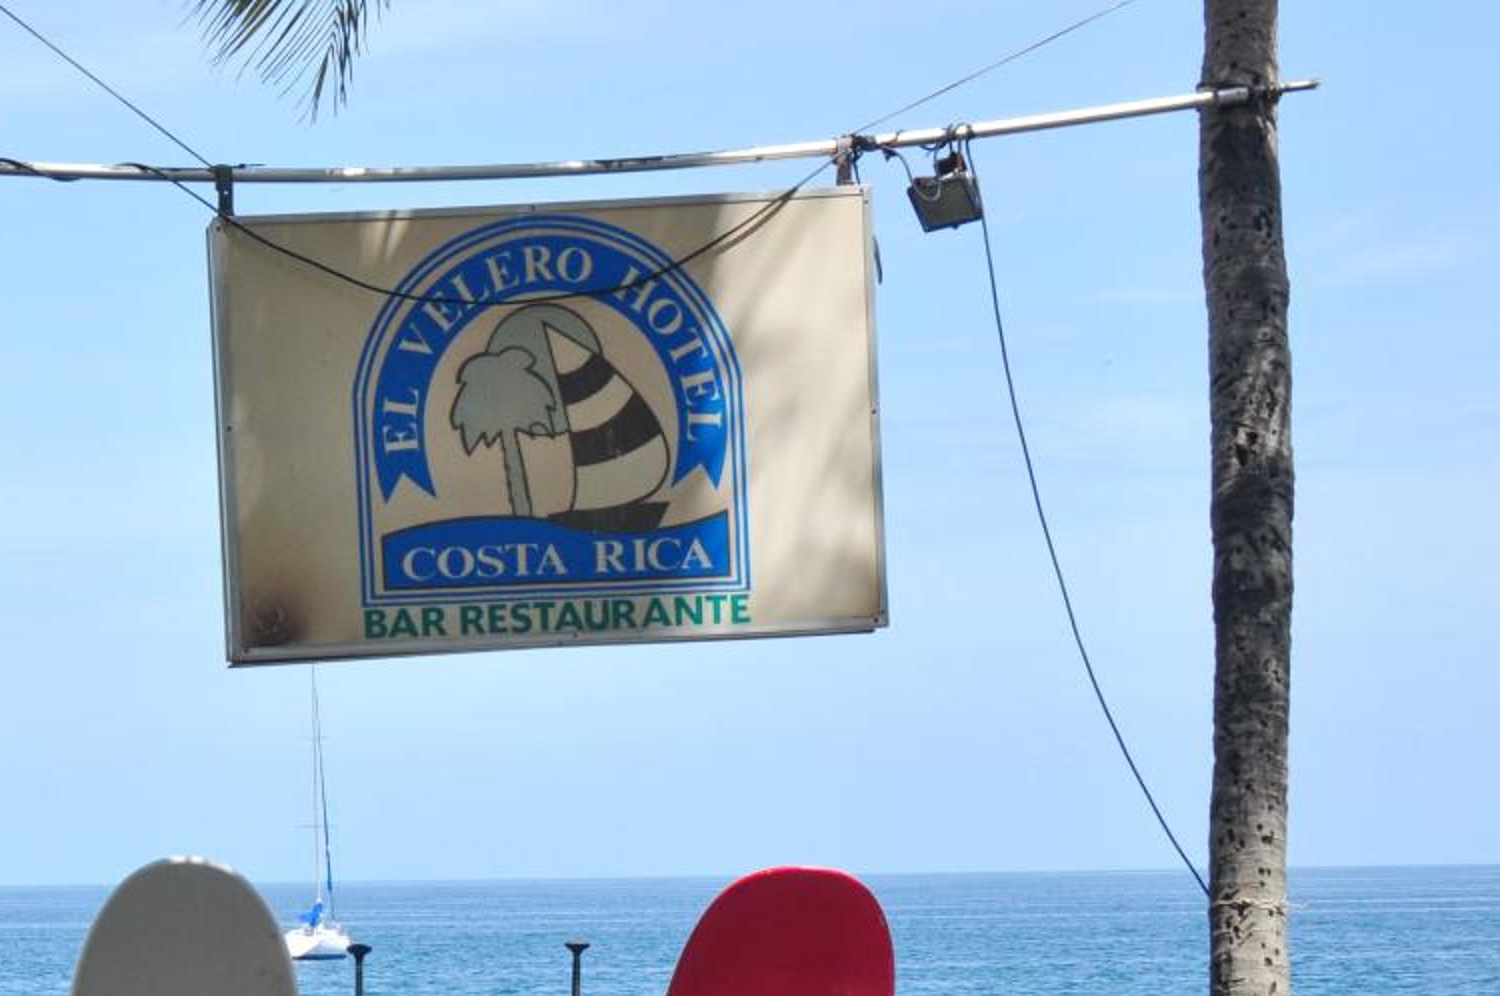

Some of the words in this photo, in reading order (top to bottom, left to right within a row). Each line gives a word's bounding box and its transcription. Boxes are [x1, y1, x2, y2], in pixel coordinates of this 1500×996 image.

[398, 245, 593, 355] VELERO
[612, 266, 722, 441] HOTEL
[383, 389, 420, 455] EL
[402, 544, 567, 581] COSTA
[594, 537, 715, 573] RICA
[364, 606, 447, 640] BAR
[460, 594, 752, 636] RESTAURANTE
